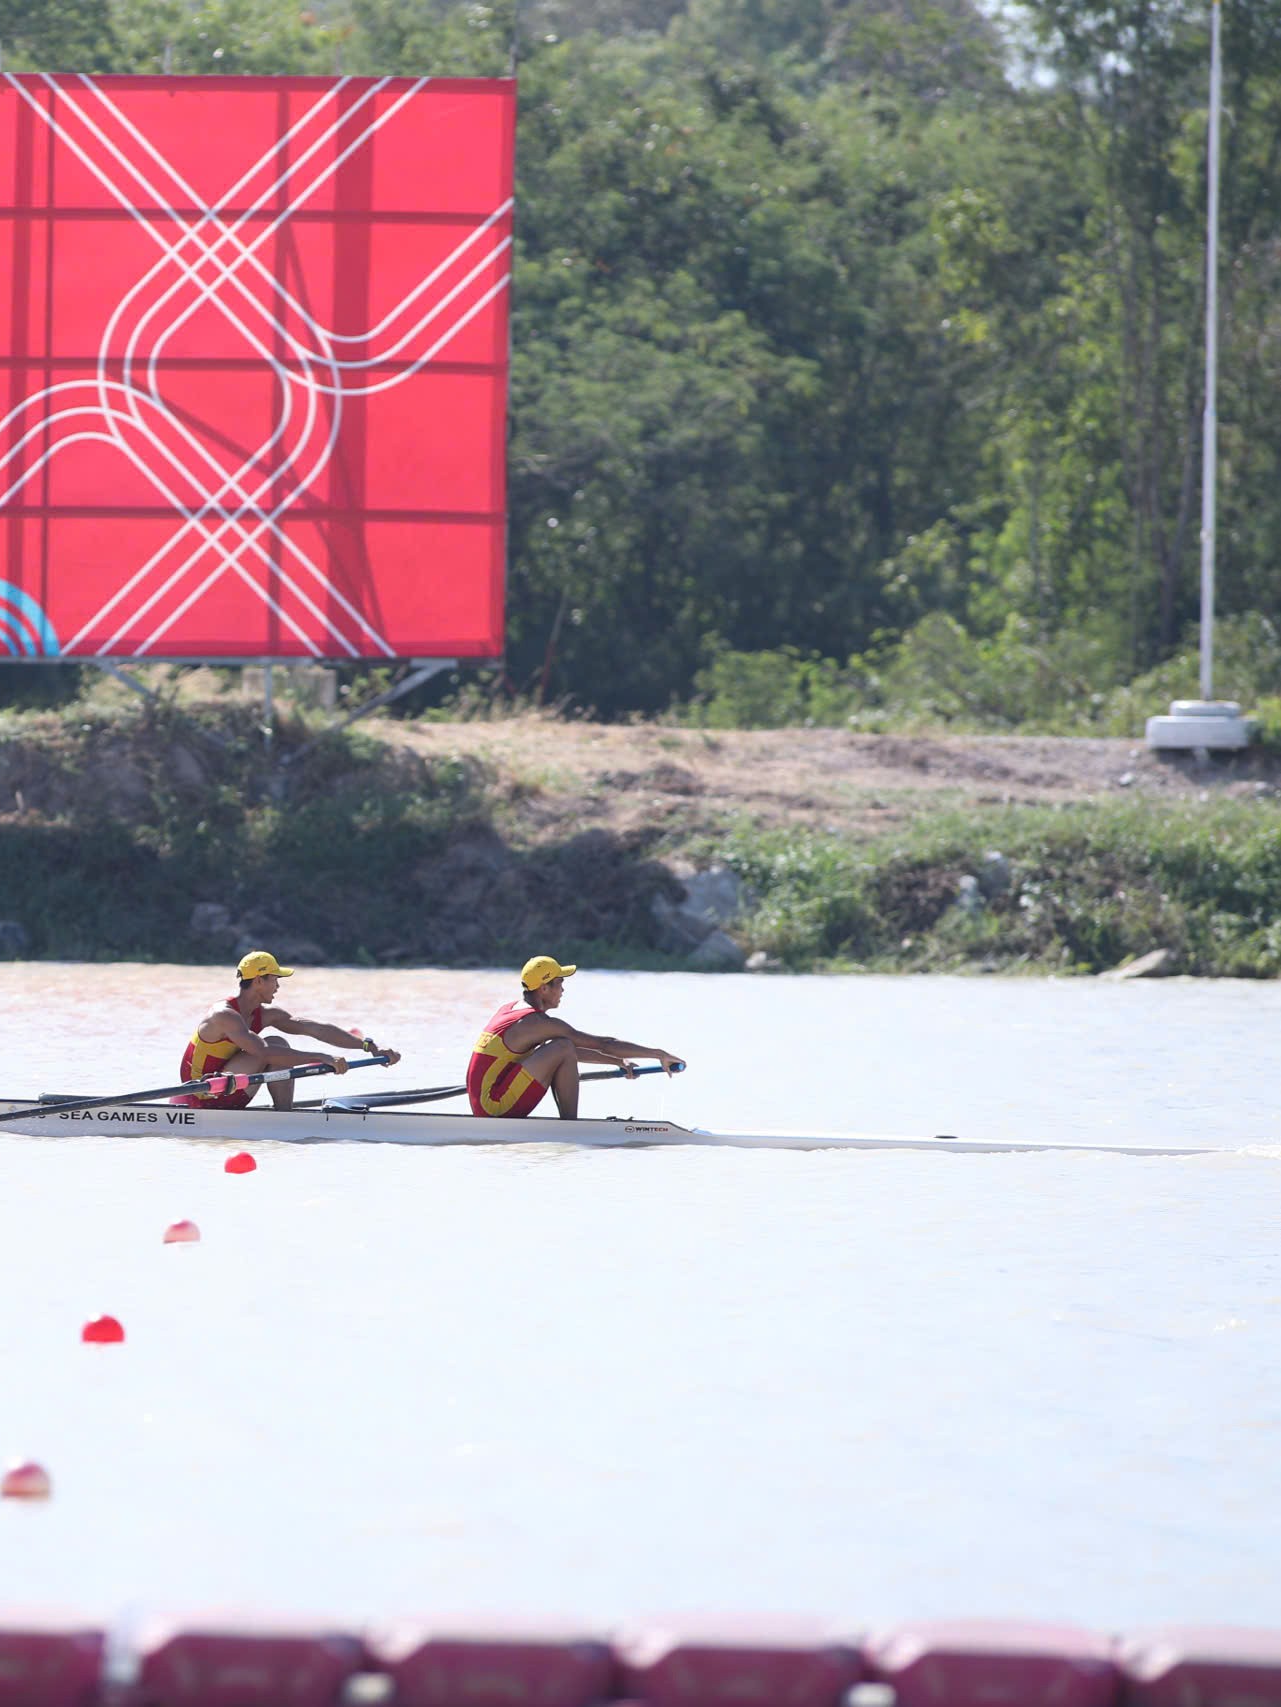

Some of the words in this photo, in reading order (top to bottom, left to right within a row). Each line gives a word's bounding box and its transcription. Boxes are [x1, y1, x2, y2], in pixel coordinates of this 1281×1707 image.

[59, 1110, 94, 1121] SEA
[97, 1111, 158, 1123] GAMES
[166, 1112, 196, 1125] VIE
